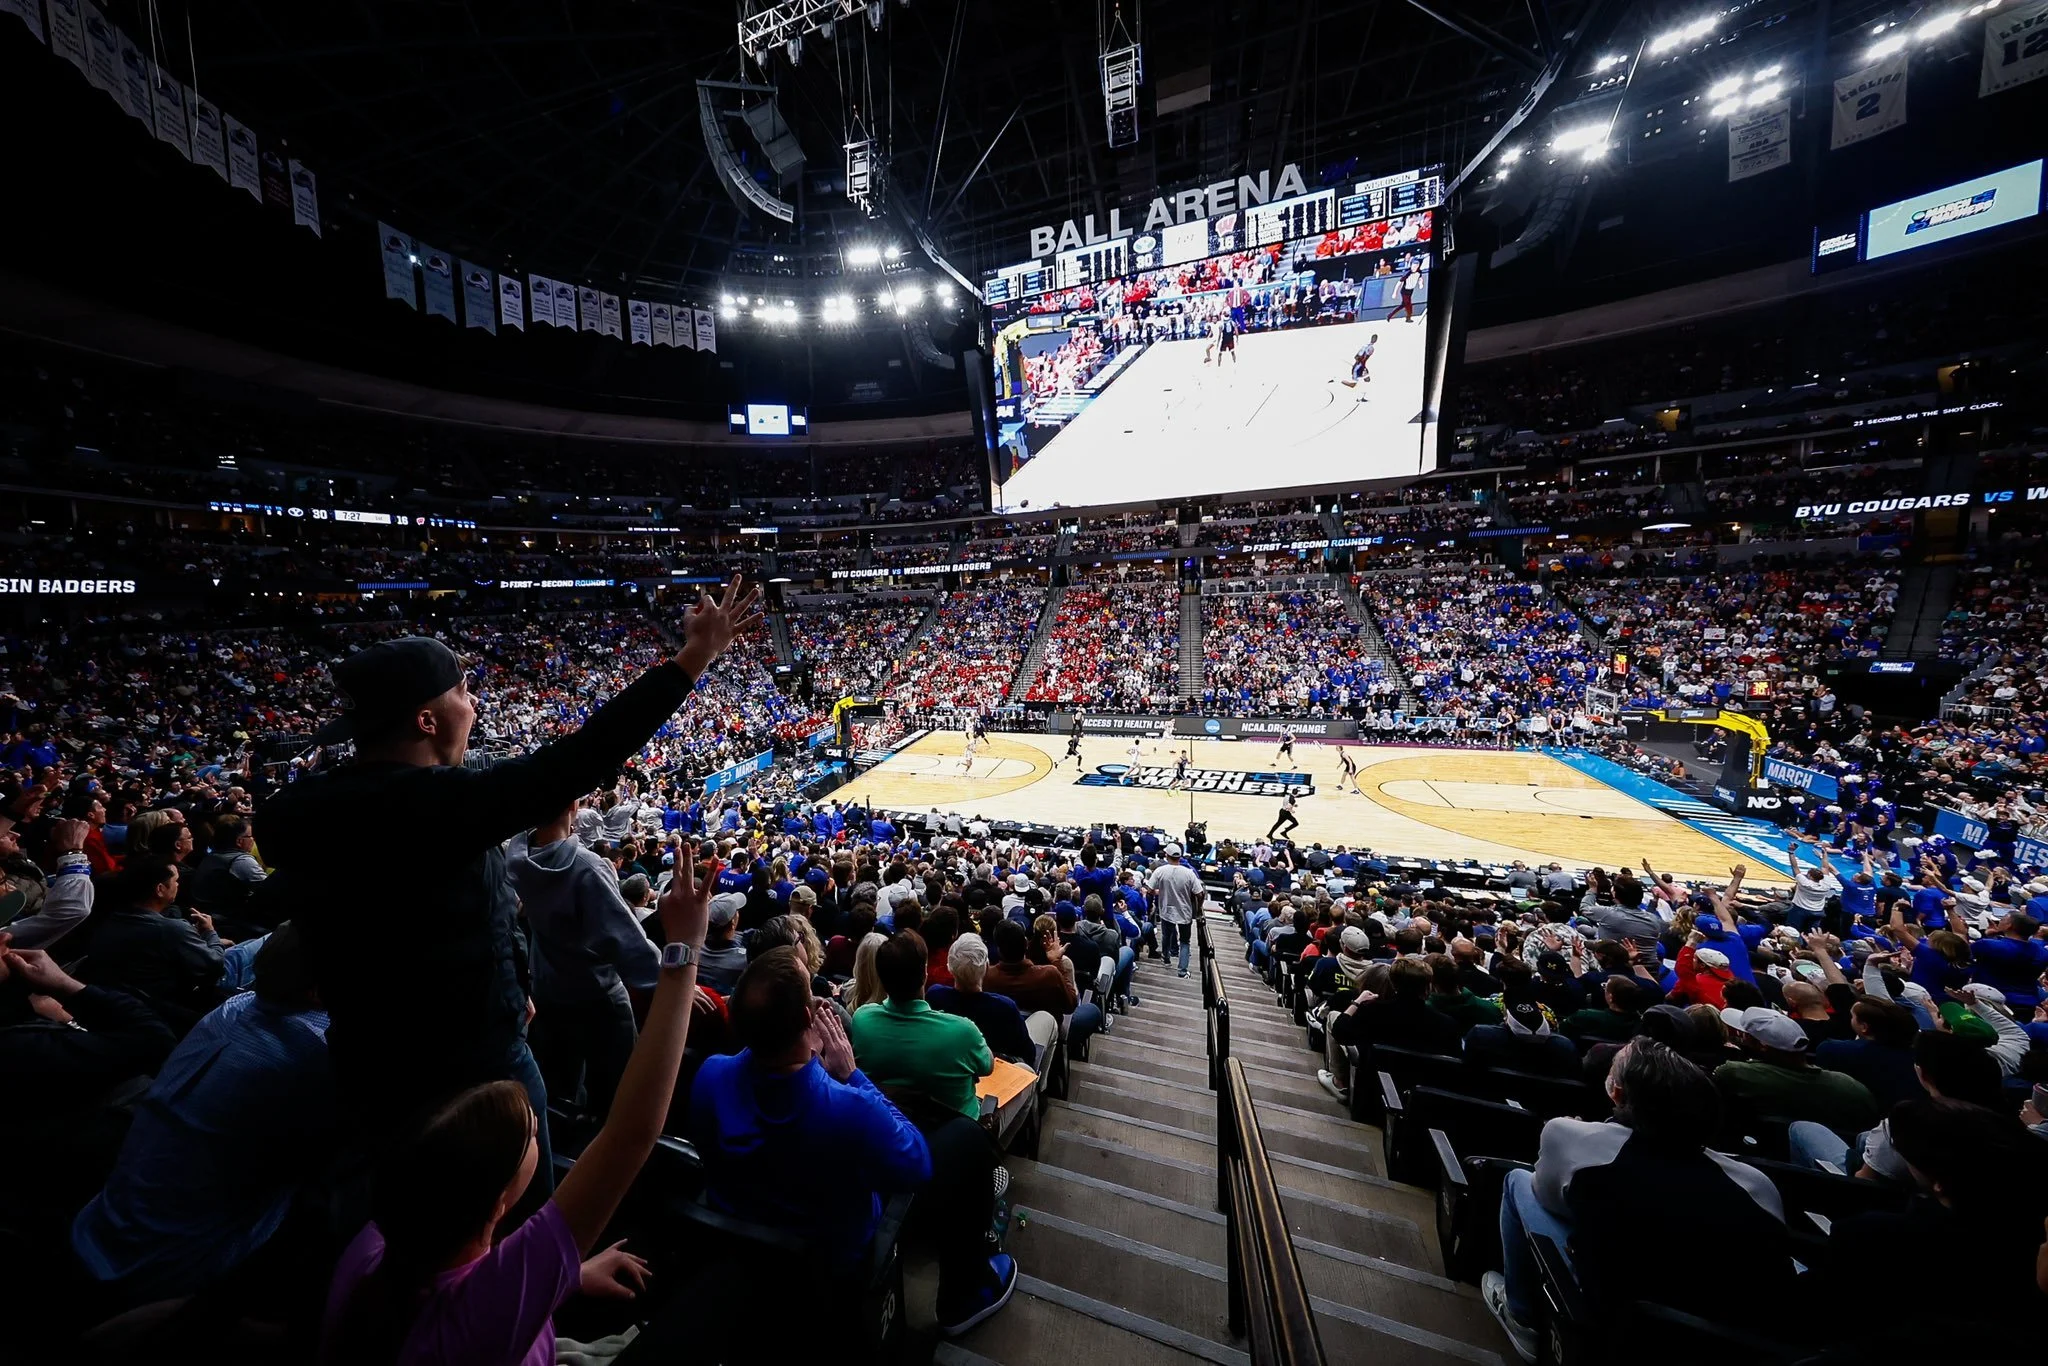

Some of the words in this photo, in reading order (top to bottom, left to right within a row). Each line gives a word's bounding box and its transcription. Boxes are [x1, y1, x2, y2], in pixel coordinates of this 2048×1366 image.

[1839, 72, 1903, 104] ENGLISH
[1856, 92, 1881, 121] 2
[1364, 174, 1411, 190] WISCONSIN
[1030, 207, 1133, 259] BALL
[1143, 163, 1308, 232] ARENA
[1925, 198, 1972, 219] MARCH
[1929, 200, 1994, 225] MADNESS
[1218, 235, 1234, 250] 16
[1867, 415, 1902, 425] SECONDS
[1943, 406, 1966, 415] SHOT
[1969, 401, 2004, 411] CLOCK.
[1795, 503, 1841, 518] BYU
[1847, 493, 1970, 514] COUGARS
[1983, 491, 2014, 503] VS
[312, 508, 328, 519] 30
[342, 512, 361, 521] 7:27
[396, 515, 409, 525] 16
[1253, 543, 1282, 552] FIRST
[1291, 540, 1329, 550] SECOND
[1331, 537, 1372, 547] ROUNDS
[832, 570, 848, 578] BYU
[850, 568, 889, 578] COUGARS
[903, 565, 951, 575] WISCONSIN
[952, 562, 992, 572] BADGERS
[0, 579, 32, 593] SIN
[38, 579, 136, 593] BADGERS
[541, 580, 574, 588] SECOND
[575, 579, 606, 587] ROUNDS
[1082, 718, 1112, 728] ACCESS
[1113, 719, 1122, 727] TO
[1124, 719, 1152, 729] HEALTH
[1241, 722, 1327, 734] NCAA.ORG/CHANGE
[735, 758, 759, 780] MARCH
[1141, 766, 1247, 783] MARCH
[1767, 762, 1814, 789] MARCH
[1138, 776, 1310, 795] MADNESS
[1747, 796, 1781, 809] NC
[881, 1292, 895, 1341] 20
[1550, 1328, 1562, 1366] 19
